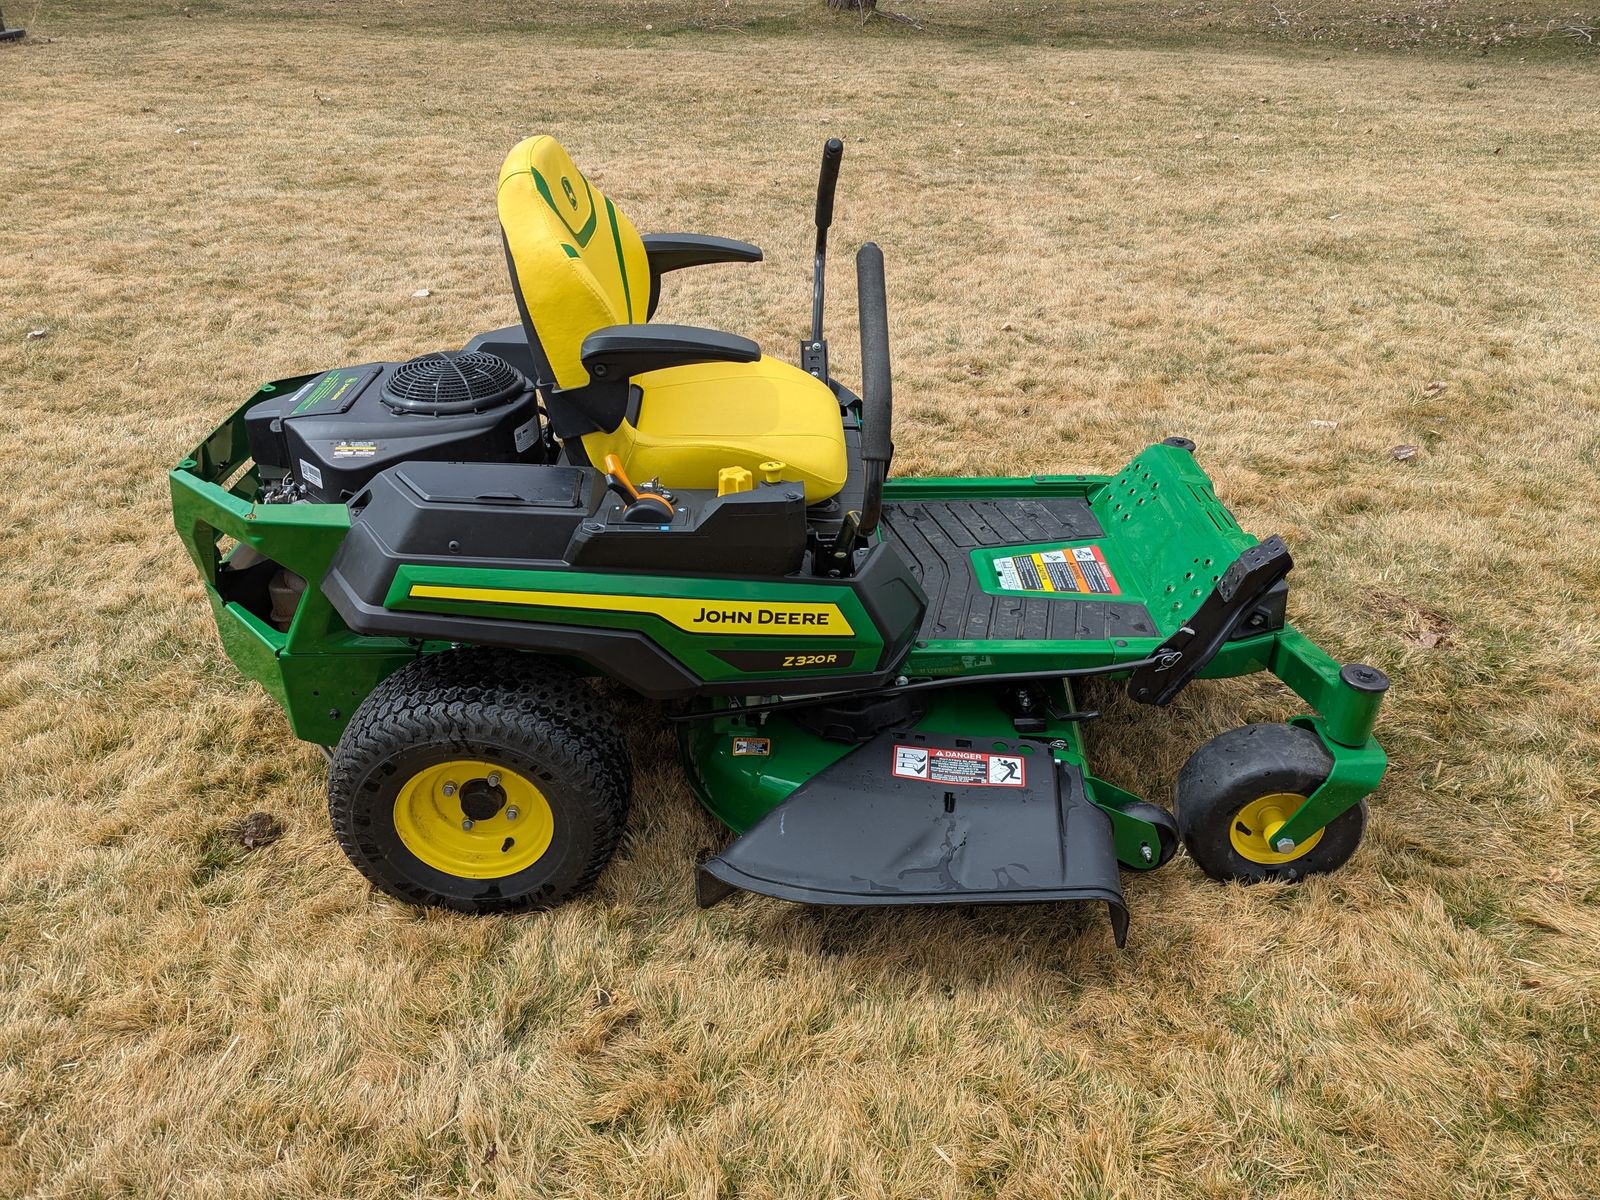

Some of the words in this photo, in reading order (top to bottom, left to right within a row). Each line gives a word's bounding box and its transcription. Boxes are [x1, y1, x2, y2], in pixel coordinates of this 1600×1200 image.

[693, 607, 752, 624] JOHN
[757, 609, 830, 625] DEERE
[945, 751, 982, 760] DANGER
